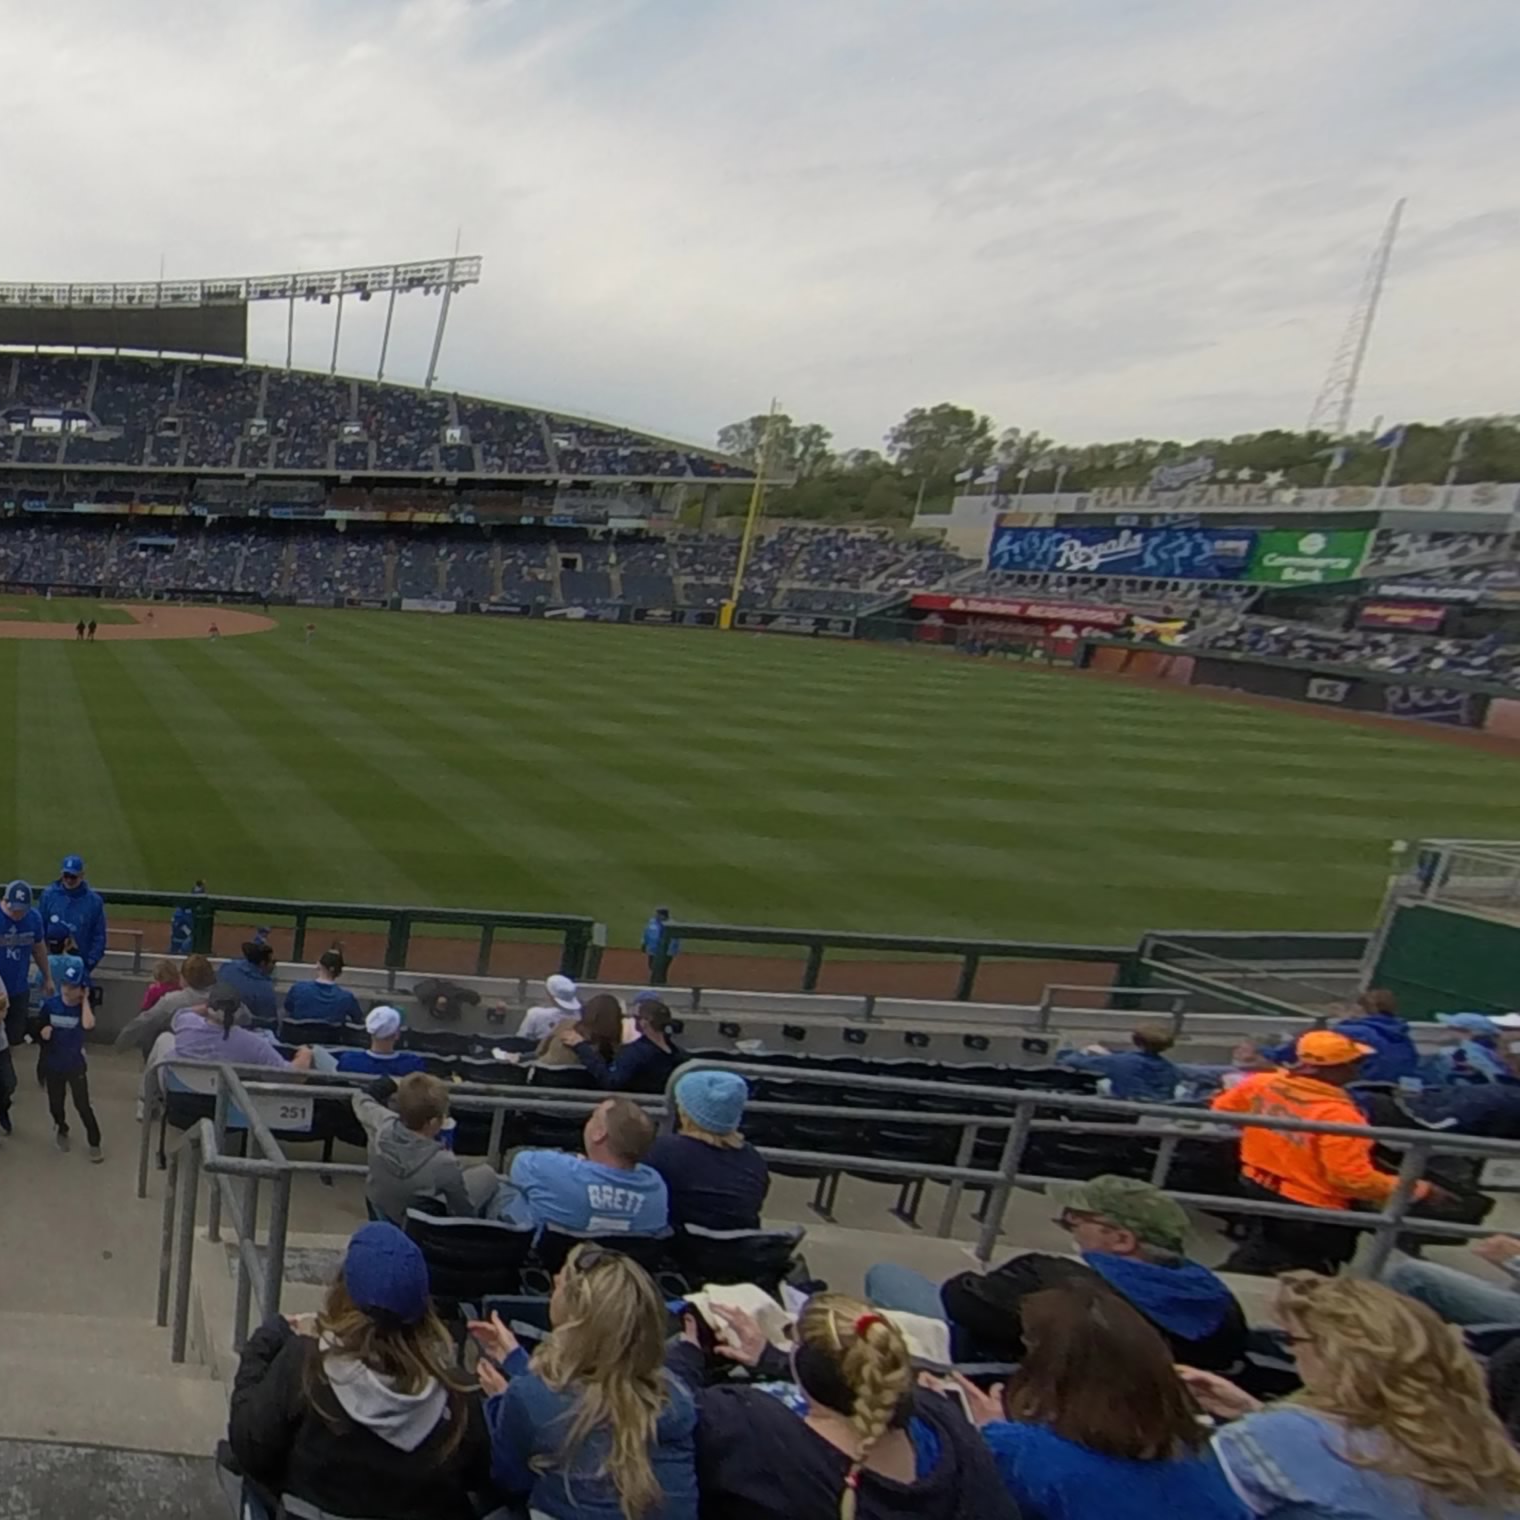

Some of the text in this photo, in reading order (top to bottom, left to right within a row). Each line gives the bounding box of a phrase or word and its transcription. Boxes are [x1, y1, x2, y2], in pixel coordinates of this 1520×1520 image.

[1090, 487, 1156, 508] HALL
[1185, 483, 1269, 507] FAME
[1055, 529, 1145, 571] Royals
[280, 1106, 307, 1119] 251
[587, 1184, 646, 1214] BRETT
